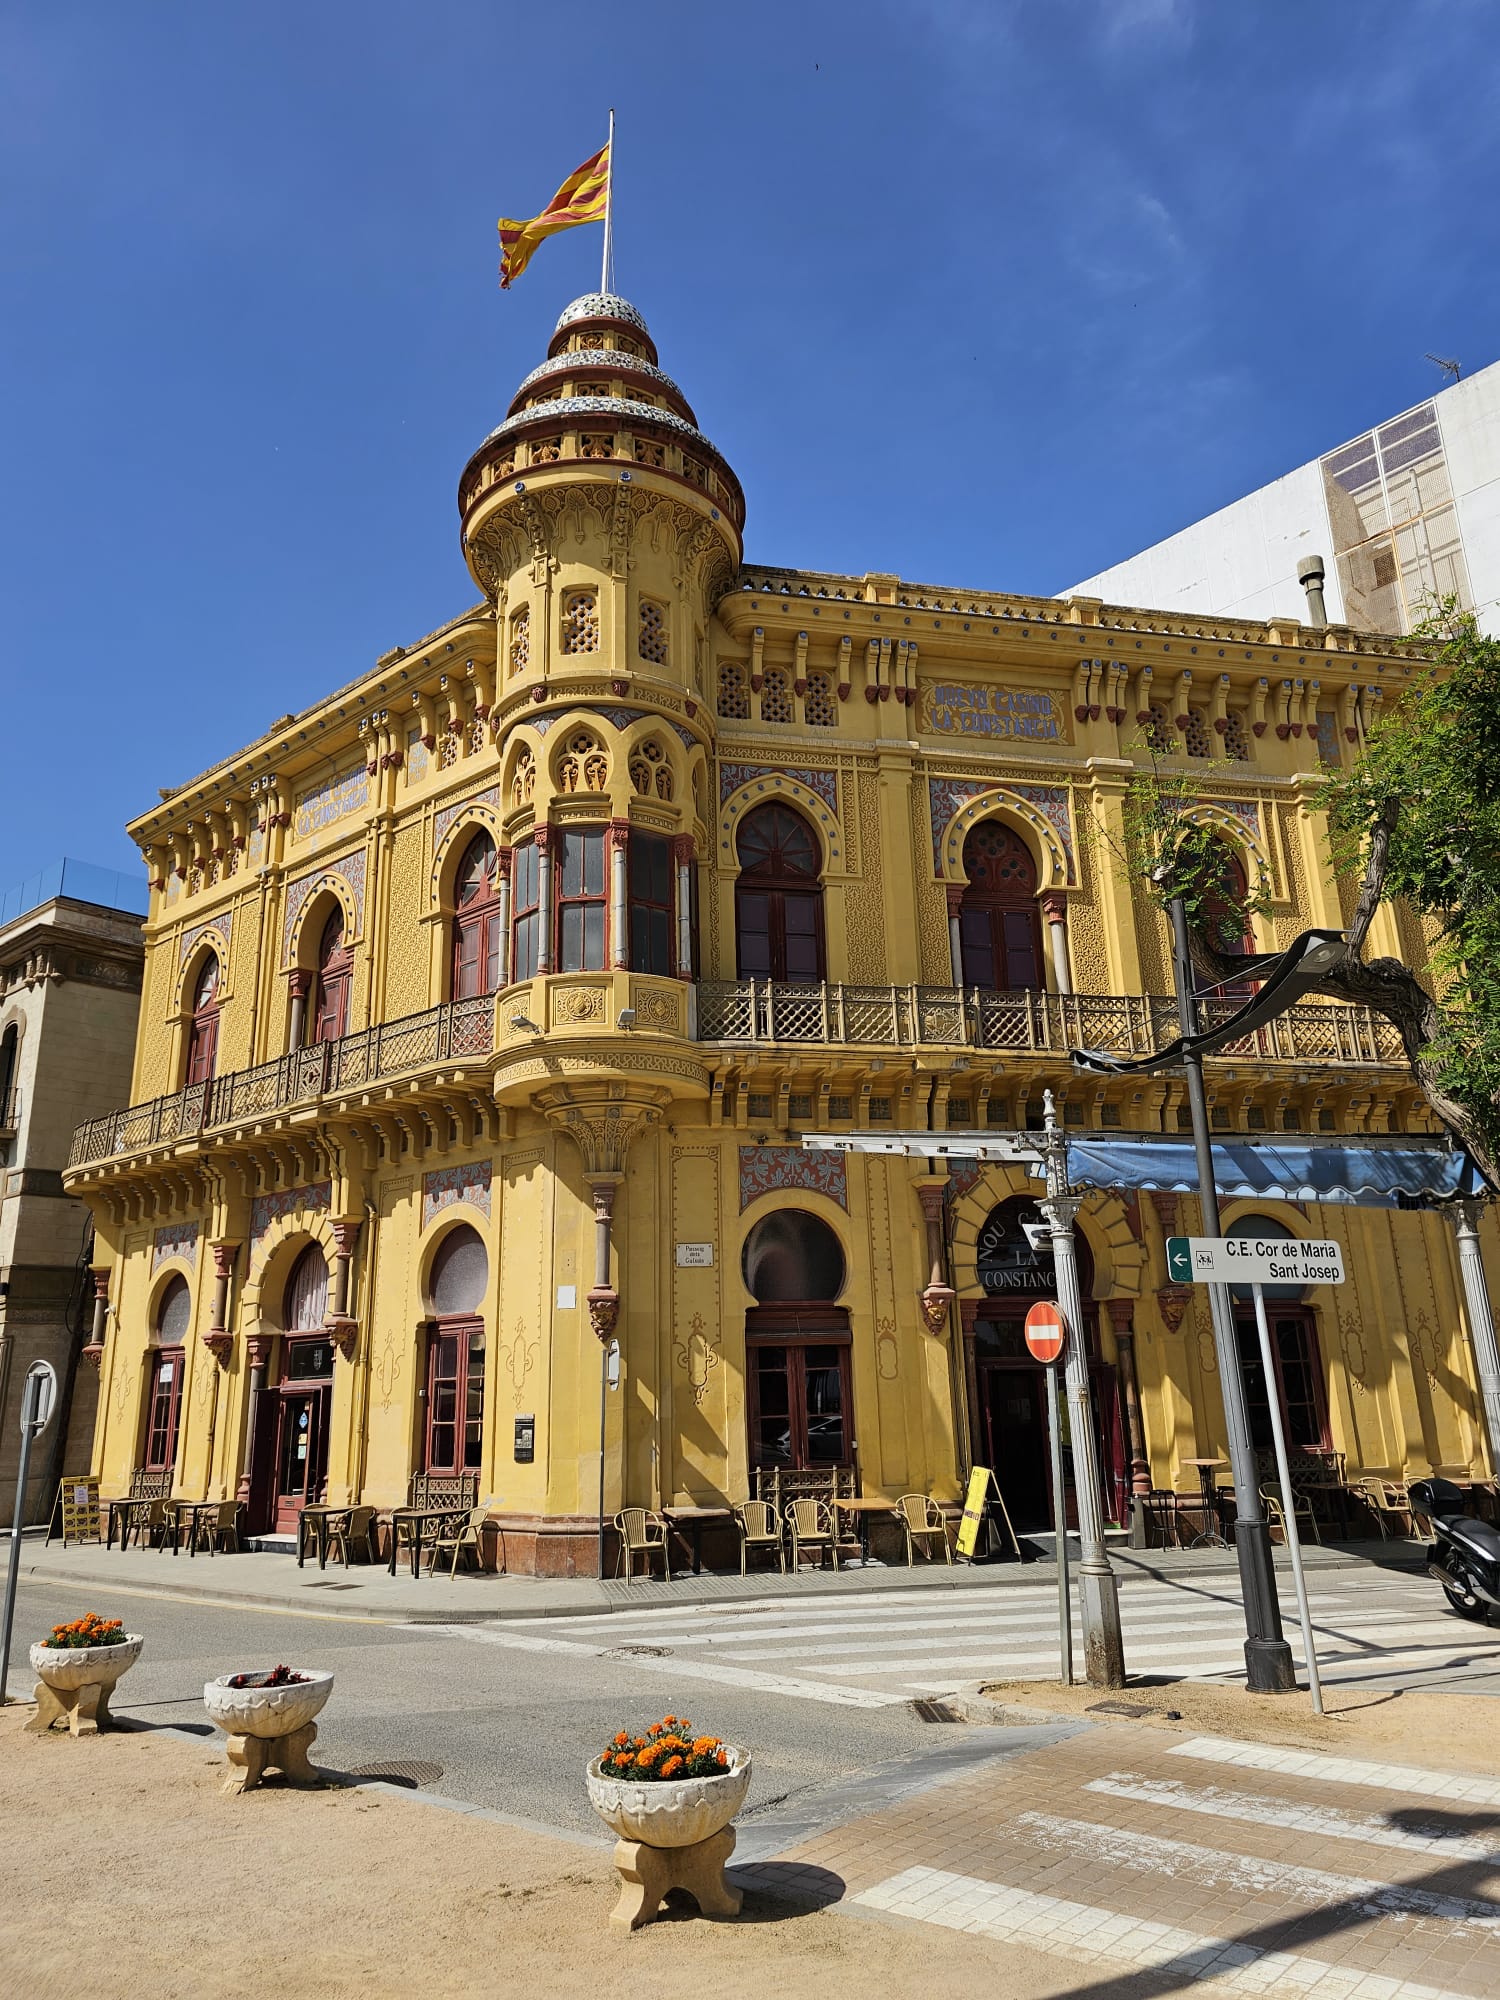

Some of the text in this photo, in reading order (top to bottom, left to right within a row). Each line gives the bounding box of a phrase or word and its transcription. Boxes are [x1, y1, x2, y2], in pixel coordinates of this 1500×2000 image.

[936, 686, 1052, 715] NUEVO CASINO
[931, 710, 1059, 738] LA CONSTANCIA
[978, 1220, 1006, 1262] NOU
[1226, 1241, 1252, 1257] C.E.
[1255, 1241, 1278, 1257] Cor
[1282, 1242, 1298, 1257] de
[1015, 1250, 1039, 1266] LA
[985, 1271, 1056, 1288] CONSTANC
[1269, 1262, 1340, 1282] Sant Josep
